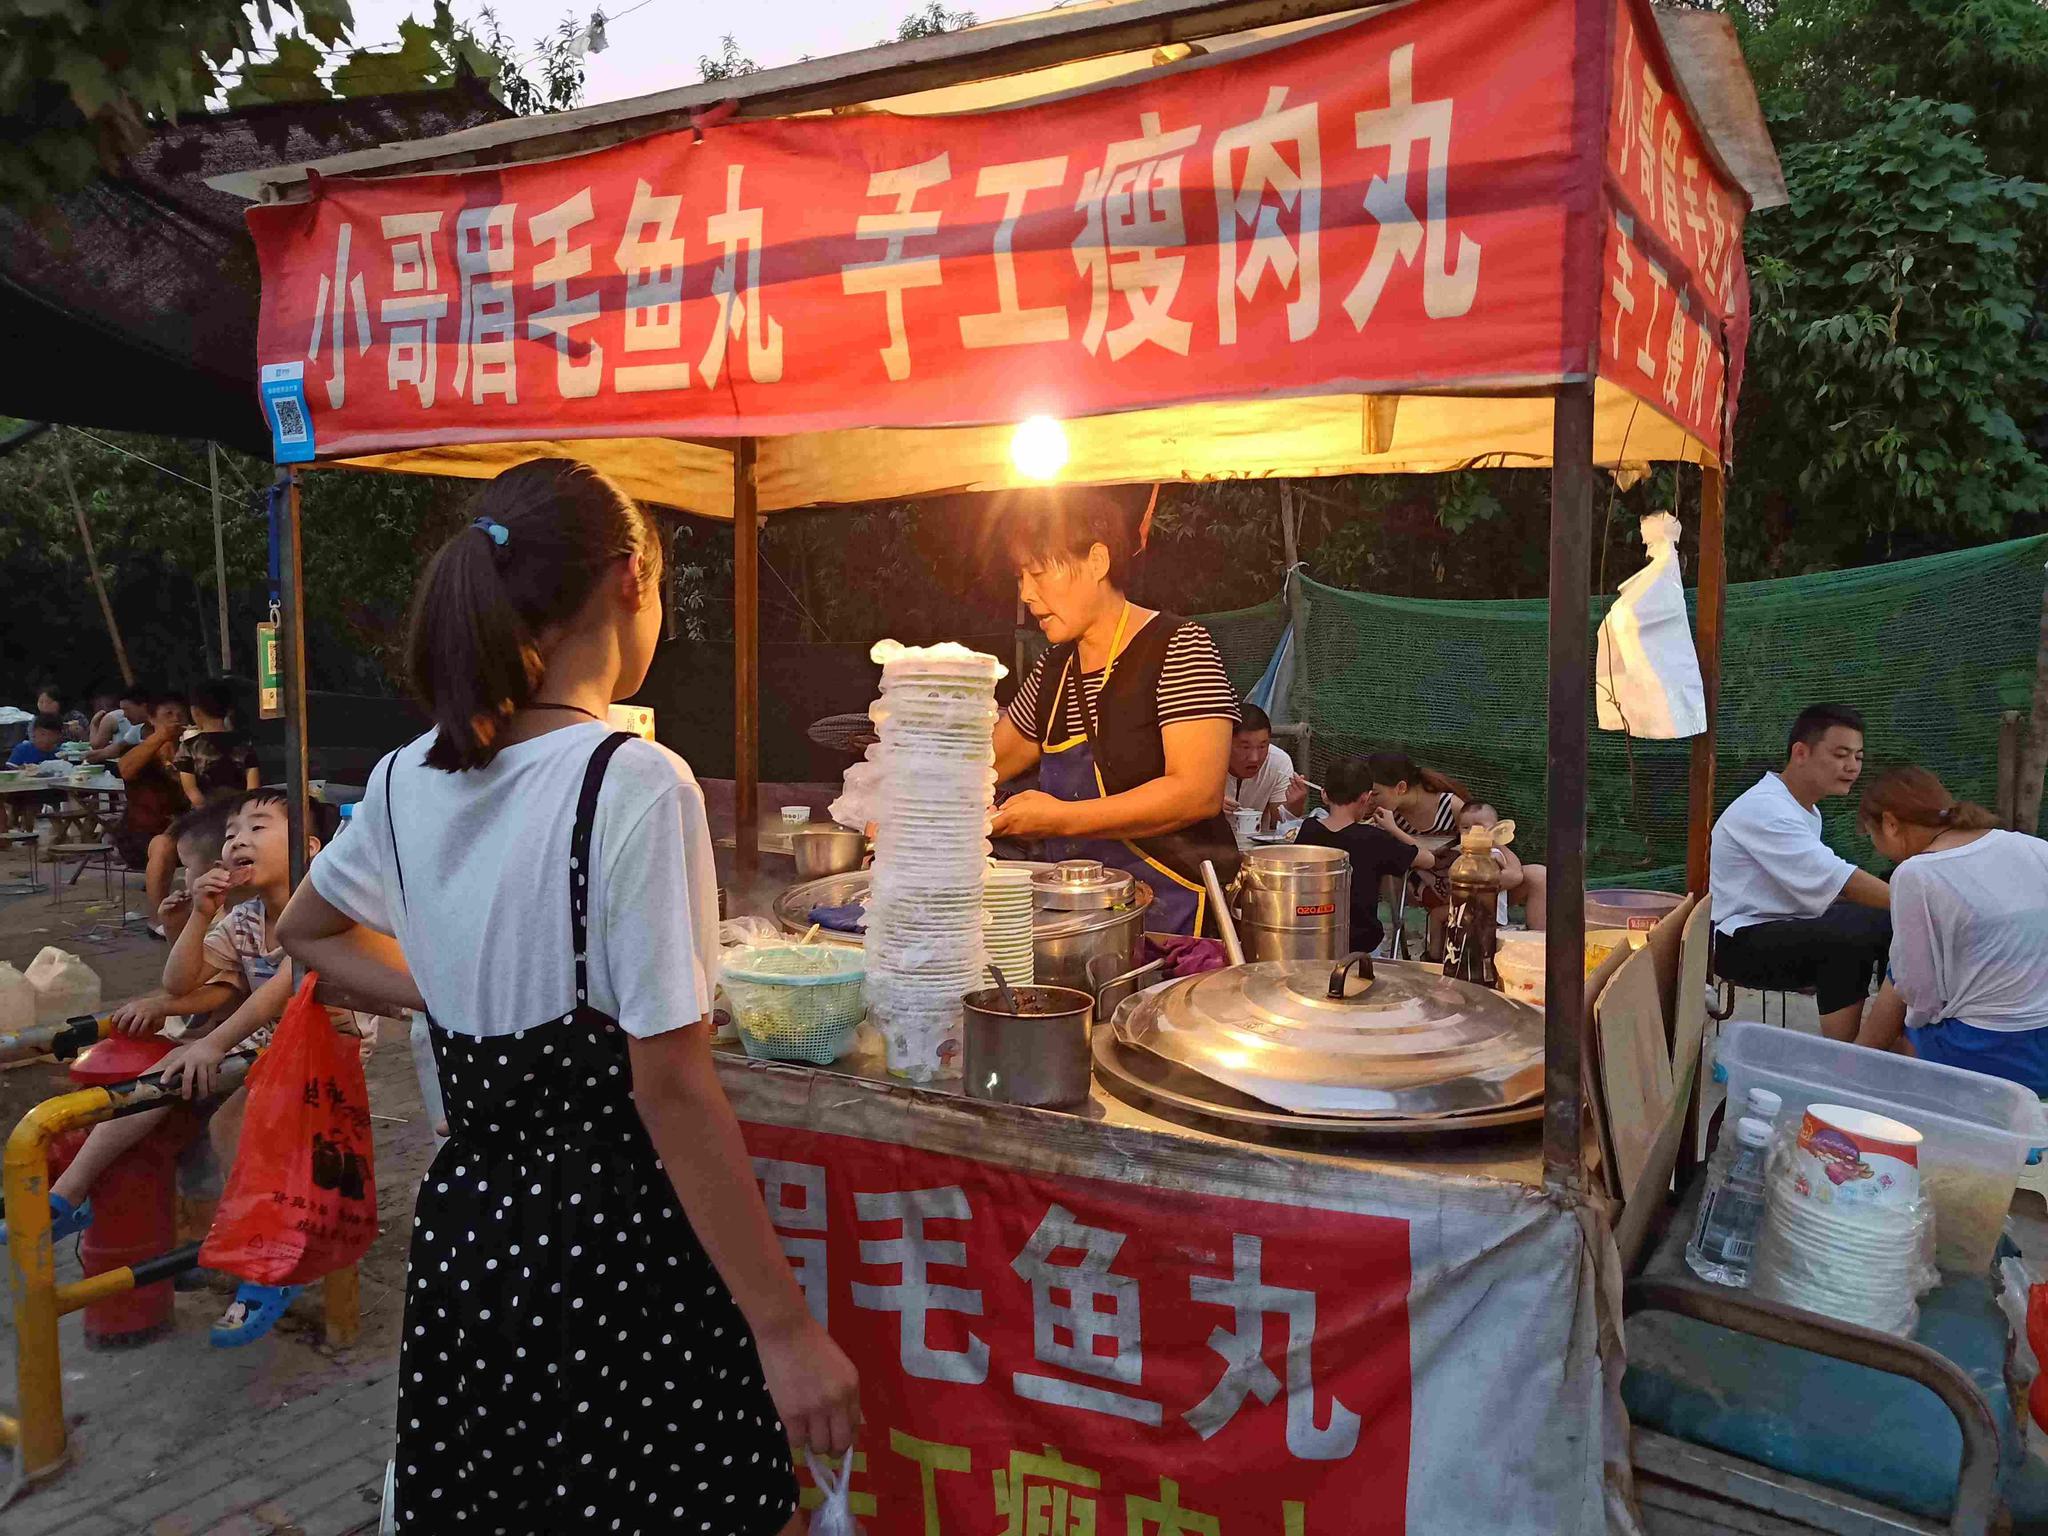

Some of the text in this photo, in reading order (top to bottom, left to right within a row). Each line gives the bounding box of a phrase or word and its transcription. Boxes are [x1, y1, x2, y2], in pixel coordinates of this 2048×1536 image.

[307, 43, 1481, 410] 小哥眉毛鱼丸 手工瘦肉丸
